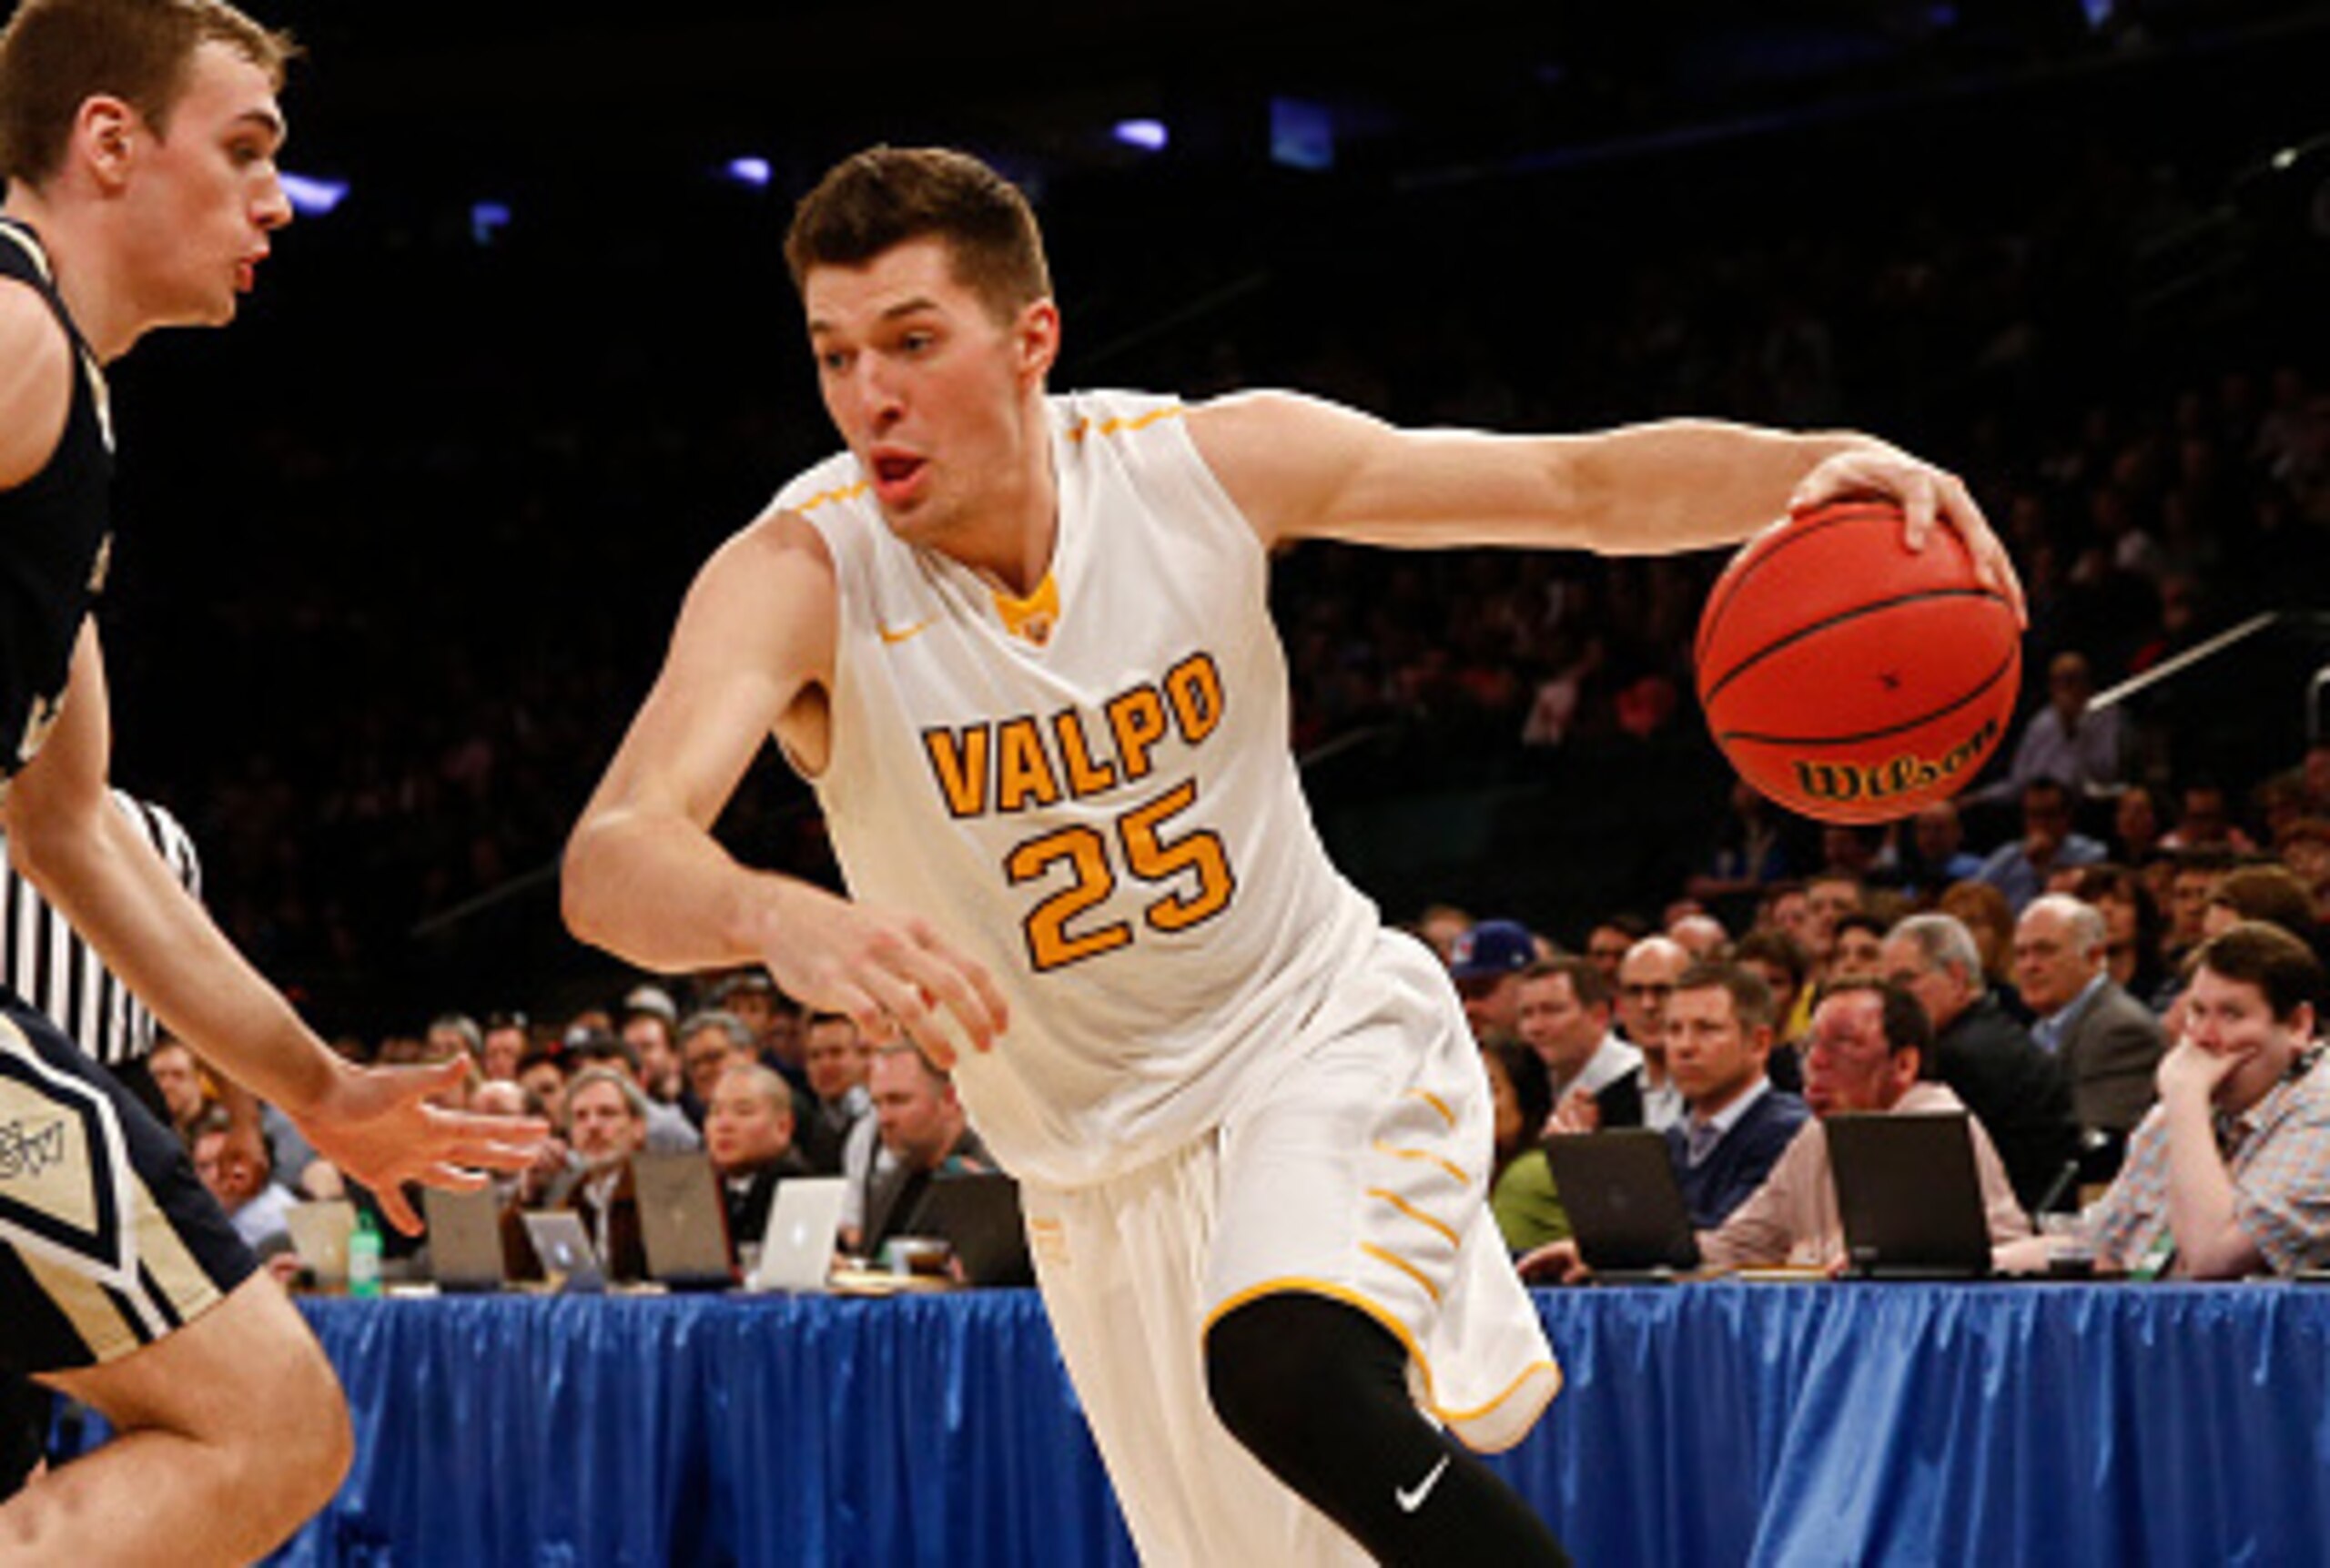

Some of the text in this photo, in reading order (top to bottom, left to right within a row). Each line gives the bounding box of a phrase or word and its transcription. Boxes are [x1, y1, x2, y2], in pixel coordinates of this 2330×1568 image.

[923, 652, 1224, 818] VALPO
[1792, 719, 1998, 802] Wilson
[1004, 777, 1236, 973] 25
